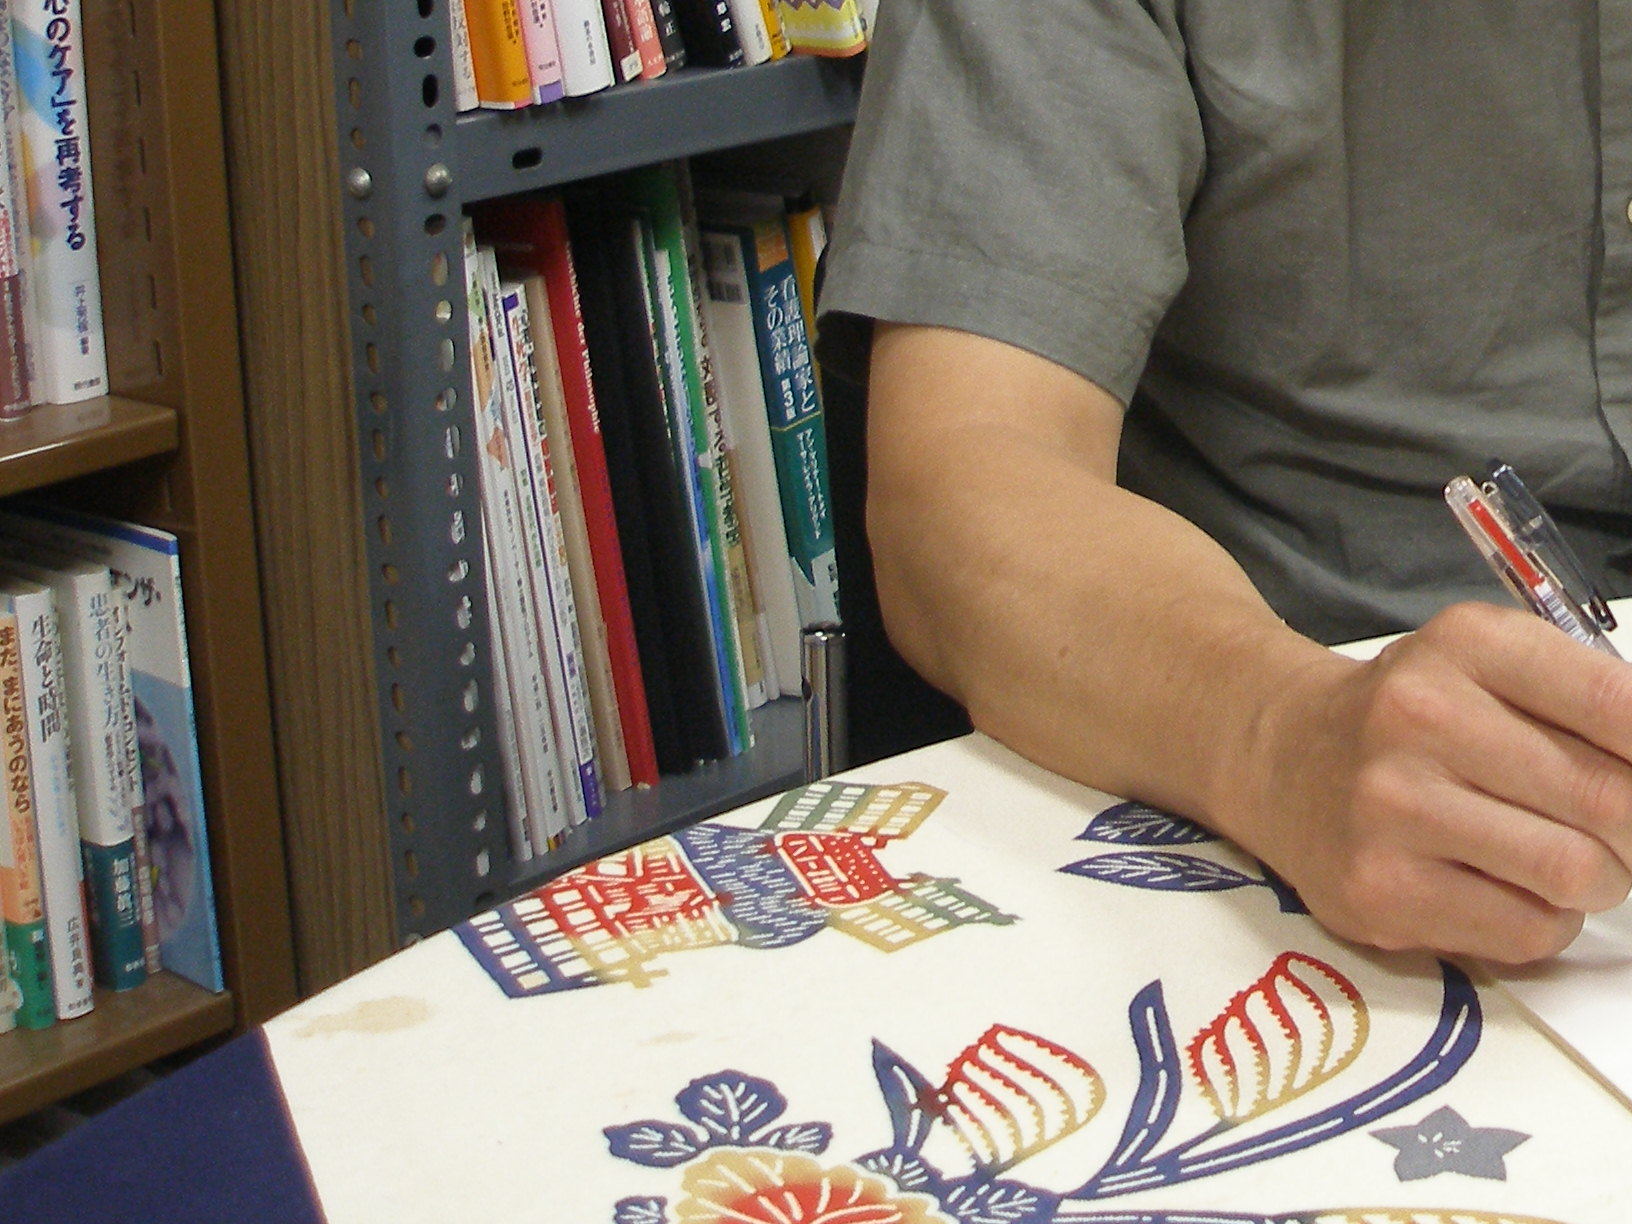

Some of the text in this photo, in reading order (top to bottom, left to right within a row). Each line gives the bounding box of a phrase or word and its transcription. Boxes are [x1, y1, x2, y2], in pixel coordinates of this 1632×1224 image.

[765, 284, 792, 376] その業績
[782, 273, 816, 413] 看護理論家と
[32, 614, 62, 743] 生命と時間
